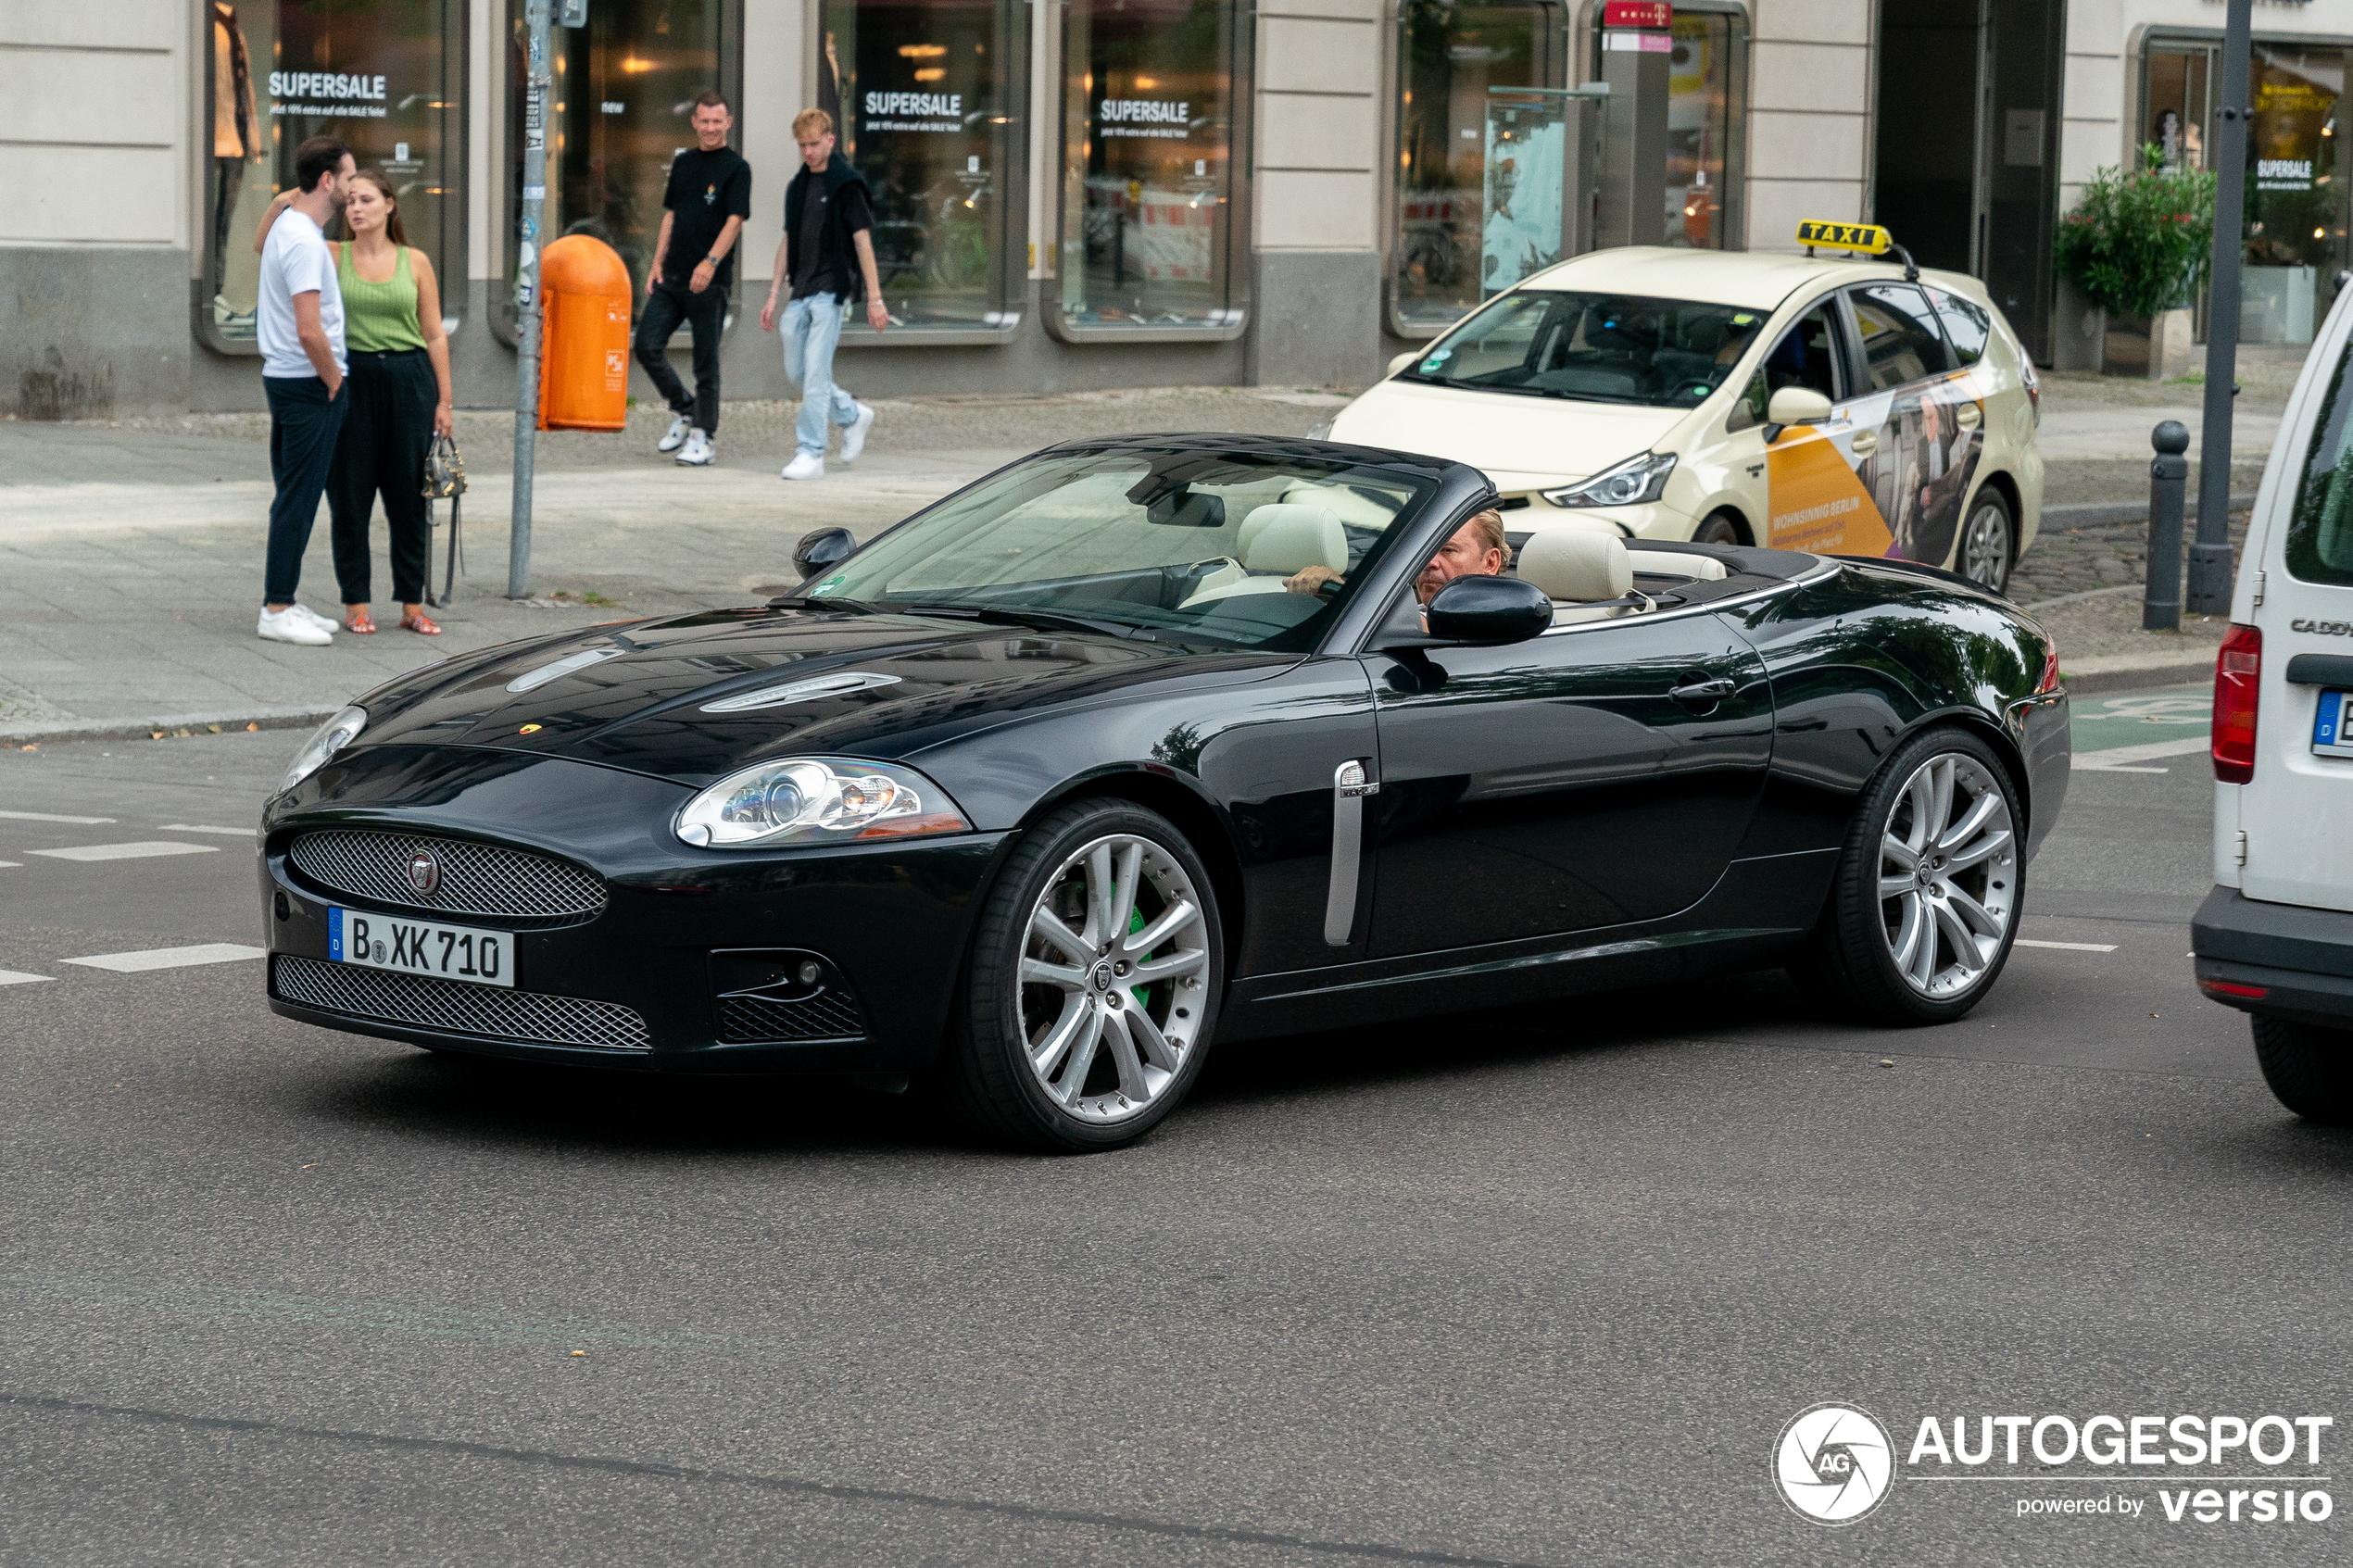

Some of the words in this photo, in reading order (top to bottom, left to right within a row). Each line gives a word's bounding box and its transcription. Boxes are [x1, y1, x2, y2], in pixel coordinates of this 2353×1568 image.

[1654, 4, 1666, 26] T
[269, 71, 386, 99] SUPERSALE
[348, 106, 368, 117] SALE
[601, 102, 624, 114] new
[865, 91, 962, 116] SUPERSALE
[1101, 99, 1189, 123] SUPERSALE
[2257, 159, 2312, 178] SUPERSALE
[1809, 224, 1866, 245] TAXI
[1773, 503, 1830, 531] WOHNSINNIG
[1831, 495, 1860, 517] BERLIN
[2321, 724, 2332, 736] D
[333, 939, 340, 950] D
[353, 918, 370, 960] B
[390, 923, 430, 971] XK
[438, 930, 498, 978] 710
